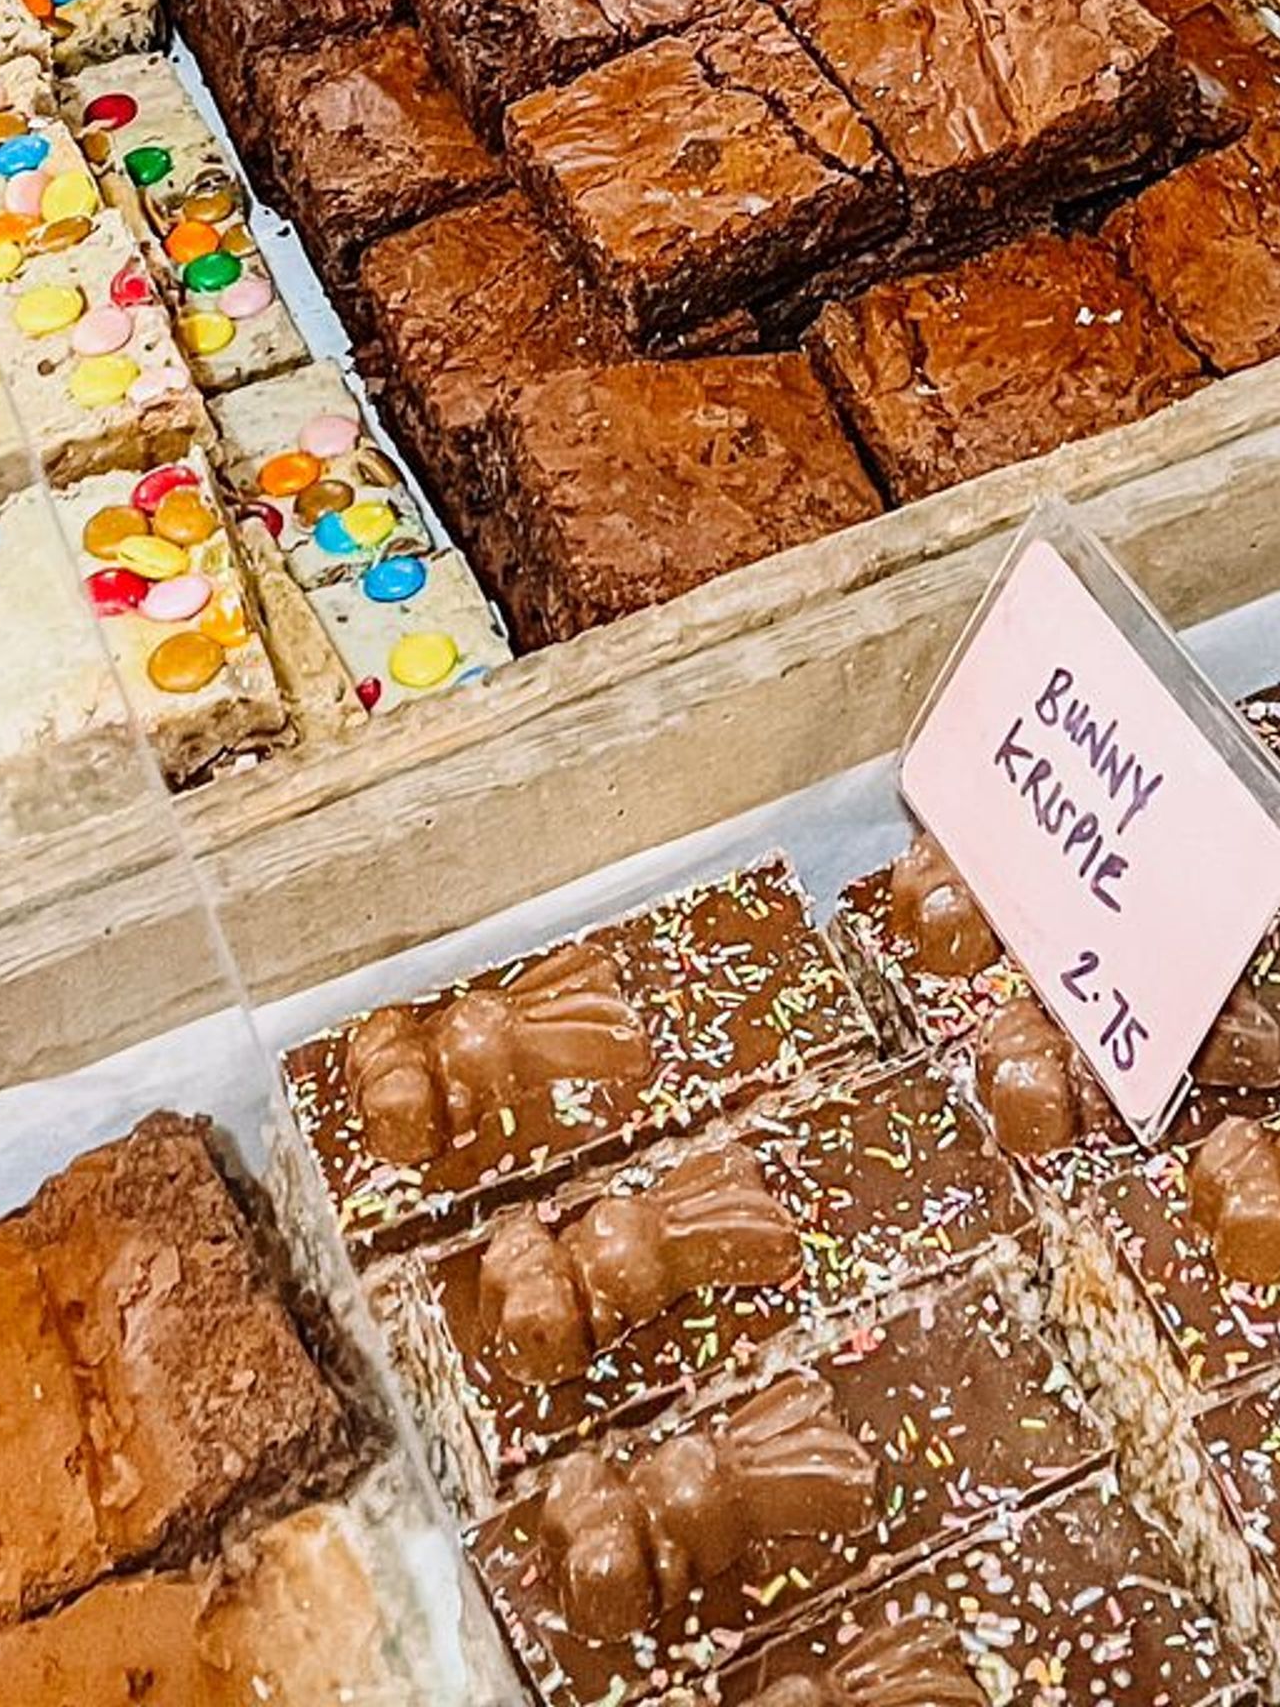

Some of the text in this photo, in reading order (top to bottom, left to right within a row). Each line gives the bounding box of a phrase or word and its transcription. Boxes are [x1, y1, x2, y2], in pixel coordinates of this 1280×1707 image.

[994, 718, 1131, 913] KRISPIE
[1034, 666, 1164, 836] BUNNY
[1059, 950, 1150, 1074] 2.75
